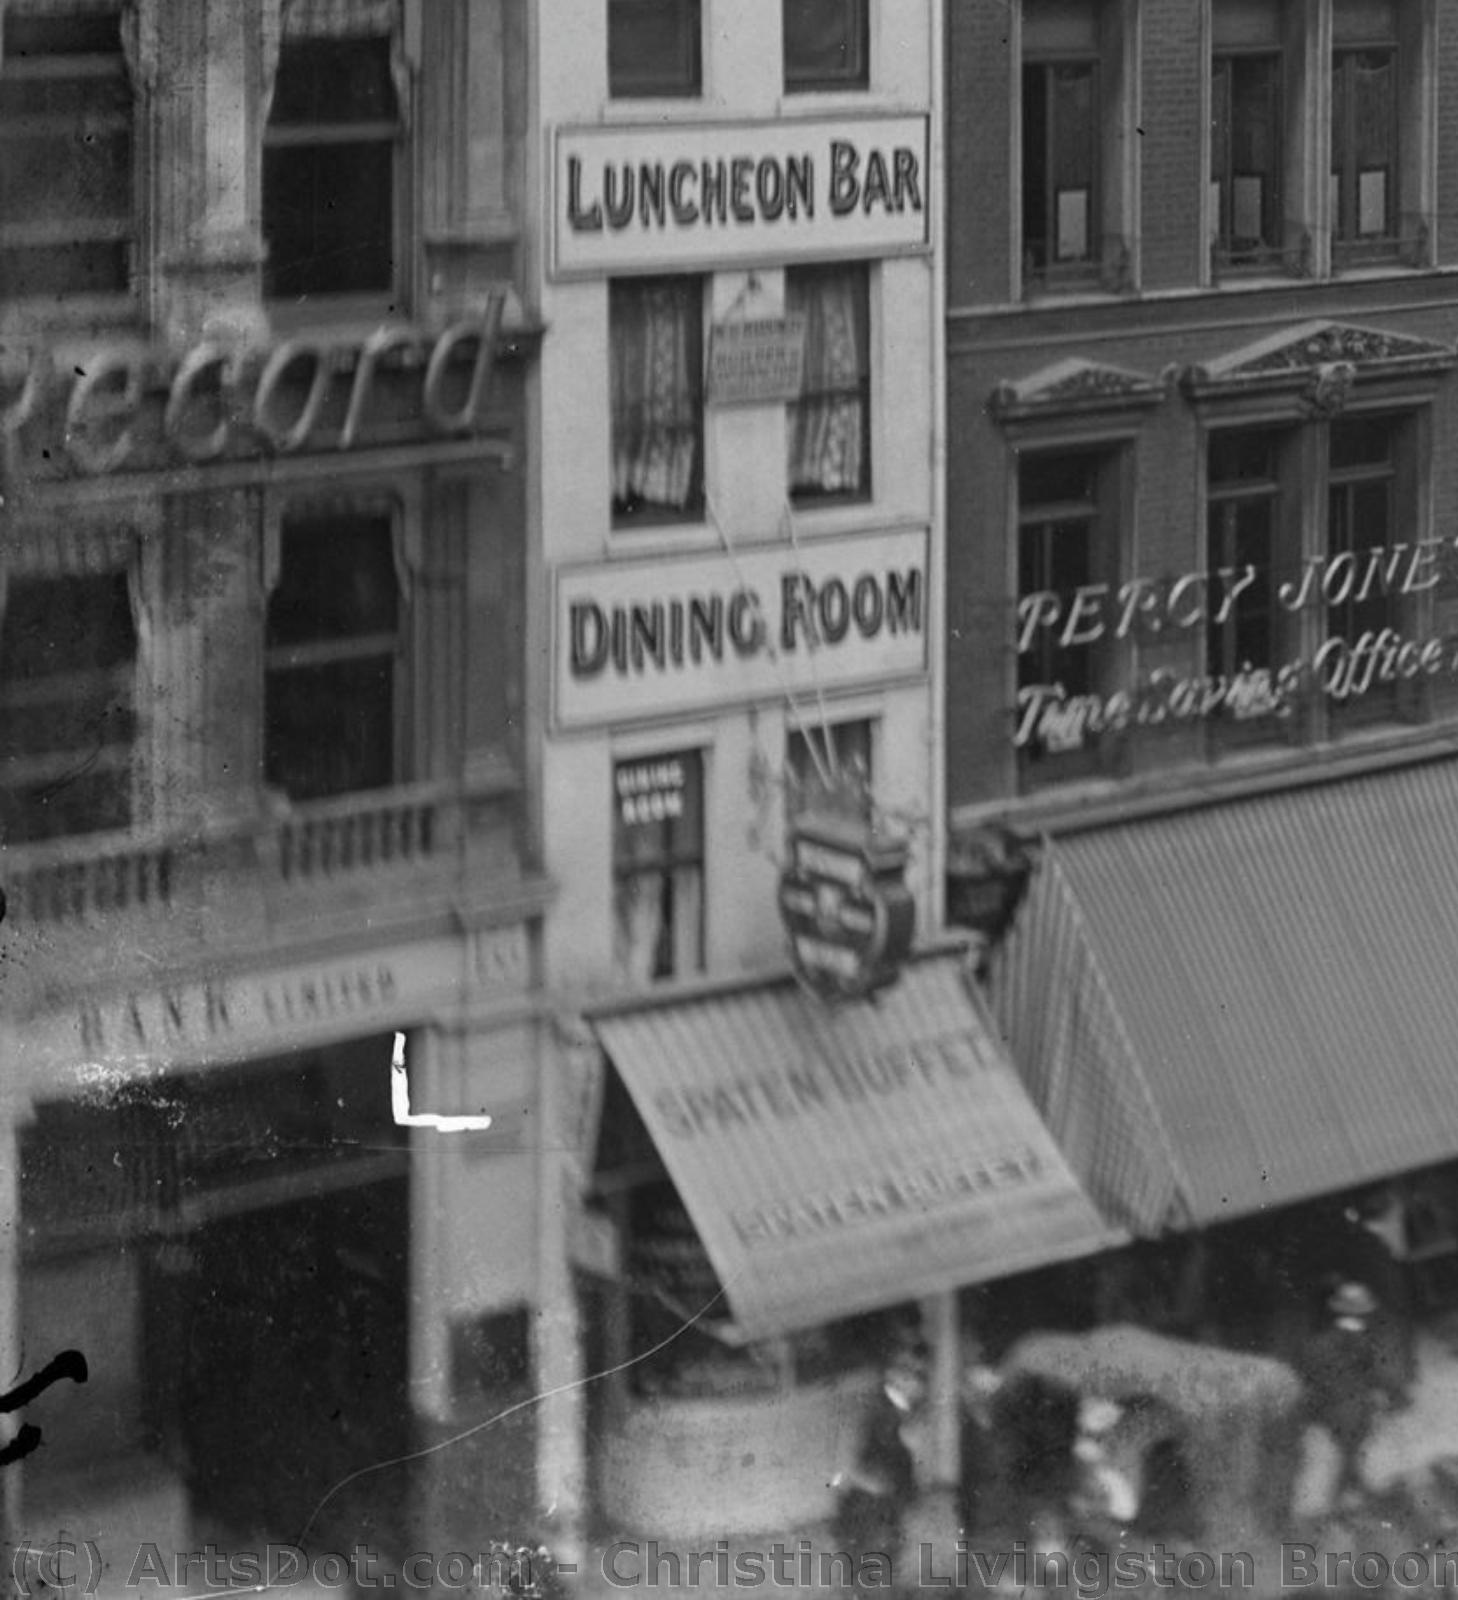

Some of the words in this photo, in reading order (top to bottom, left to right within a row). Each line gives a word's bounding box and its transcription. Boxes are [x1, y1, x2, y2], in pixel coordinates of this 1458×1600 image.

[566, 151, 815, 232] LUNCHEON
[828, 138, 923, 216] BAR
[569, 590, 764, 681] DINING
[779, 569, 923, 653] ROOM
[1018, 564, 1256, 654] PERCY
[1313, 625, 1442, 699] Office
